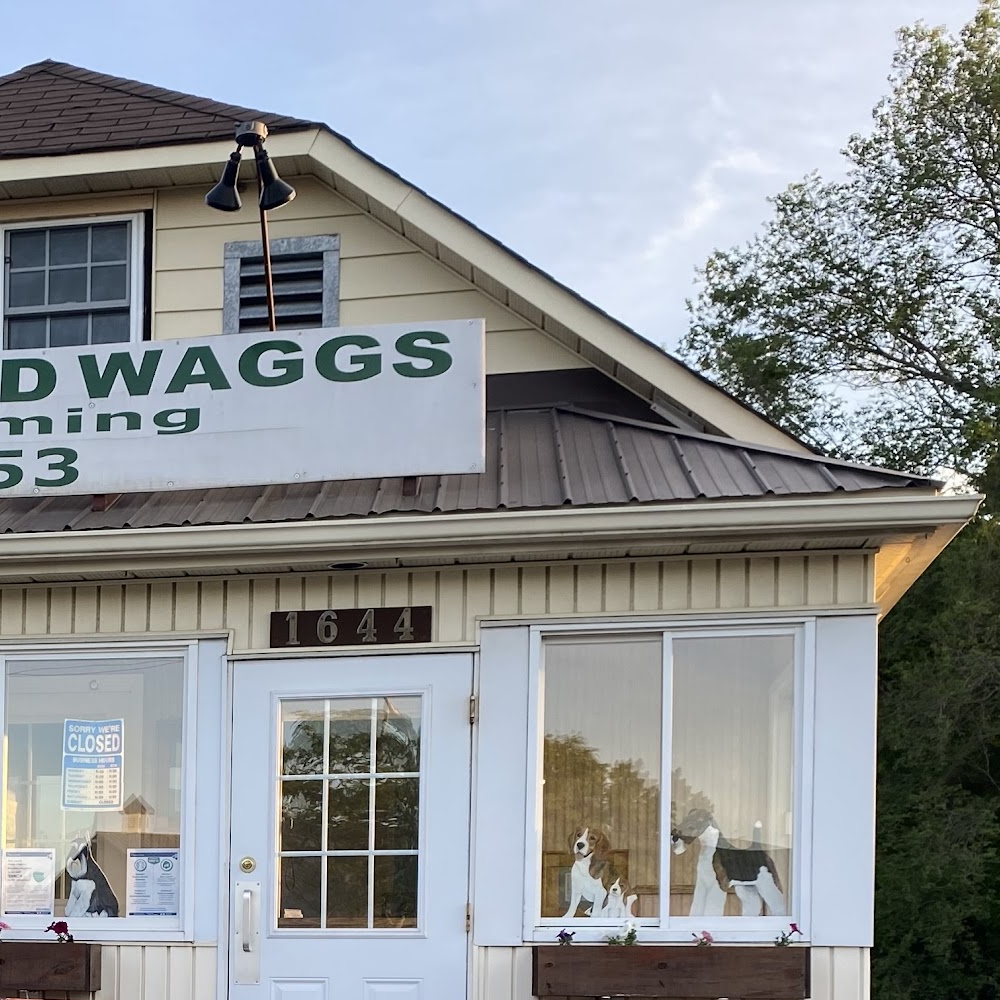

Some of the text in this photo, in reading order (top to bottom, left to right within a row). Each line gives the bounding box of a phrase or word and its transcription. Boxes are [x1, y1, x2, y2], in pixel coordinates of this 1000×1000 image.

[78, 331, 454, 400] WAGGS
[285, 608, 415, 645] 1644
[67, 733, 120, 753] CLOSED
[68, 725, 120, 733] SORRY WE'RE
